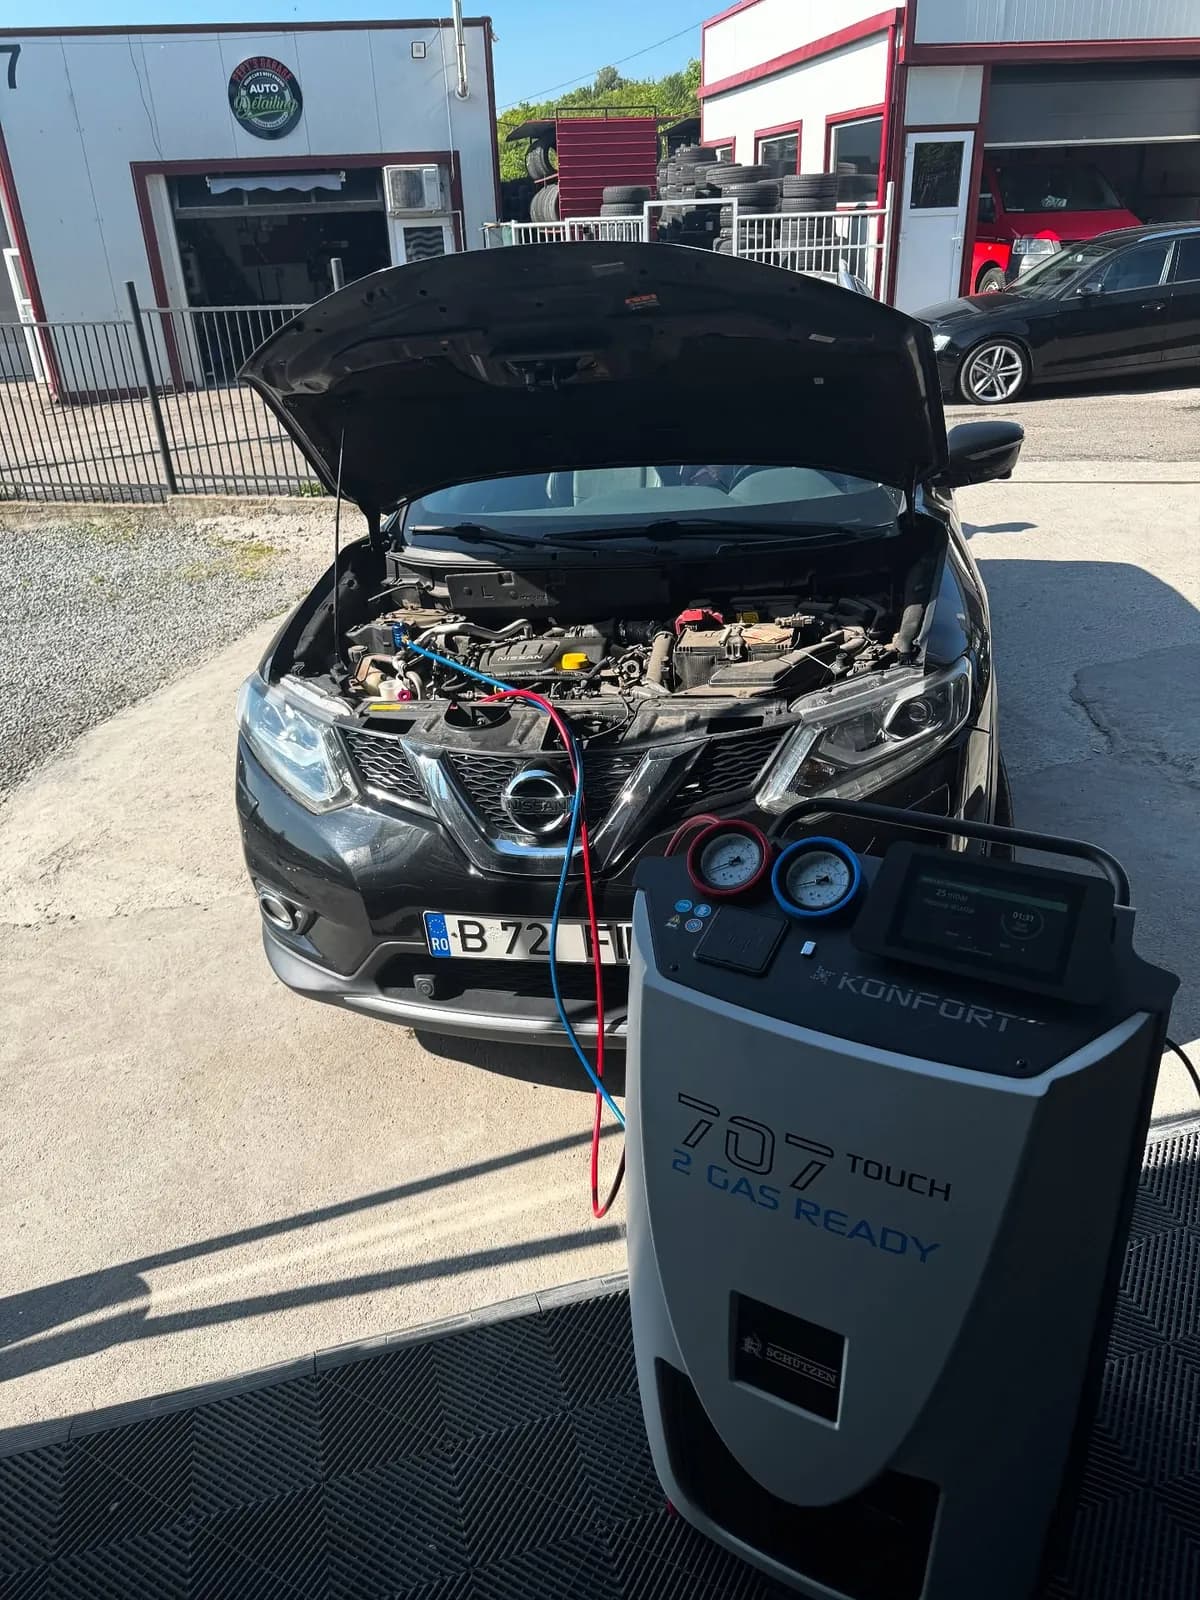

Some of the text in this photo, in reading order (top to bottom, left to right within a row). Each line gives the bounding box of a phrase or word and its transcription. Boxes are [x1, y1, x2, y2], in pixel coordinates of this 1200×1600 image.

[249, 83, 279, 93] AUTO
[233, 95, 299, 119] Detailing
[497, 654, 544, 662] NISSAN
[507, 799, 565, 812] NISSAN
[432, 937, 448, 951] RO
[457, 919, 488, 953] B
[500, 921, 553, 955] 72
[837, 972, 1018, 1032] KONFORT
[677, 1092, 953, 1202] 707 TOUCH
[671, 1150, 941, 1264] 2 GAS READY
